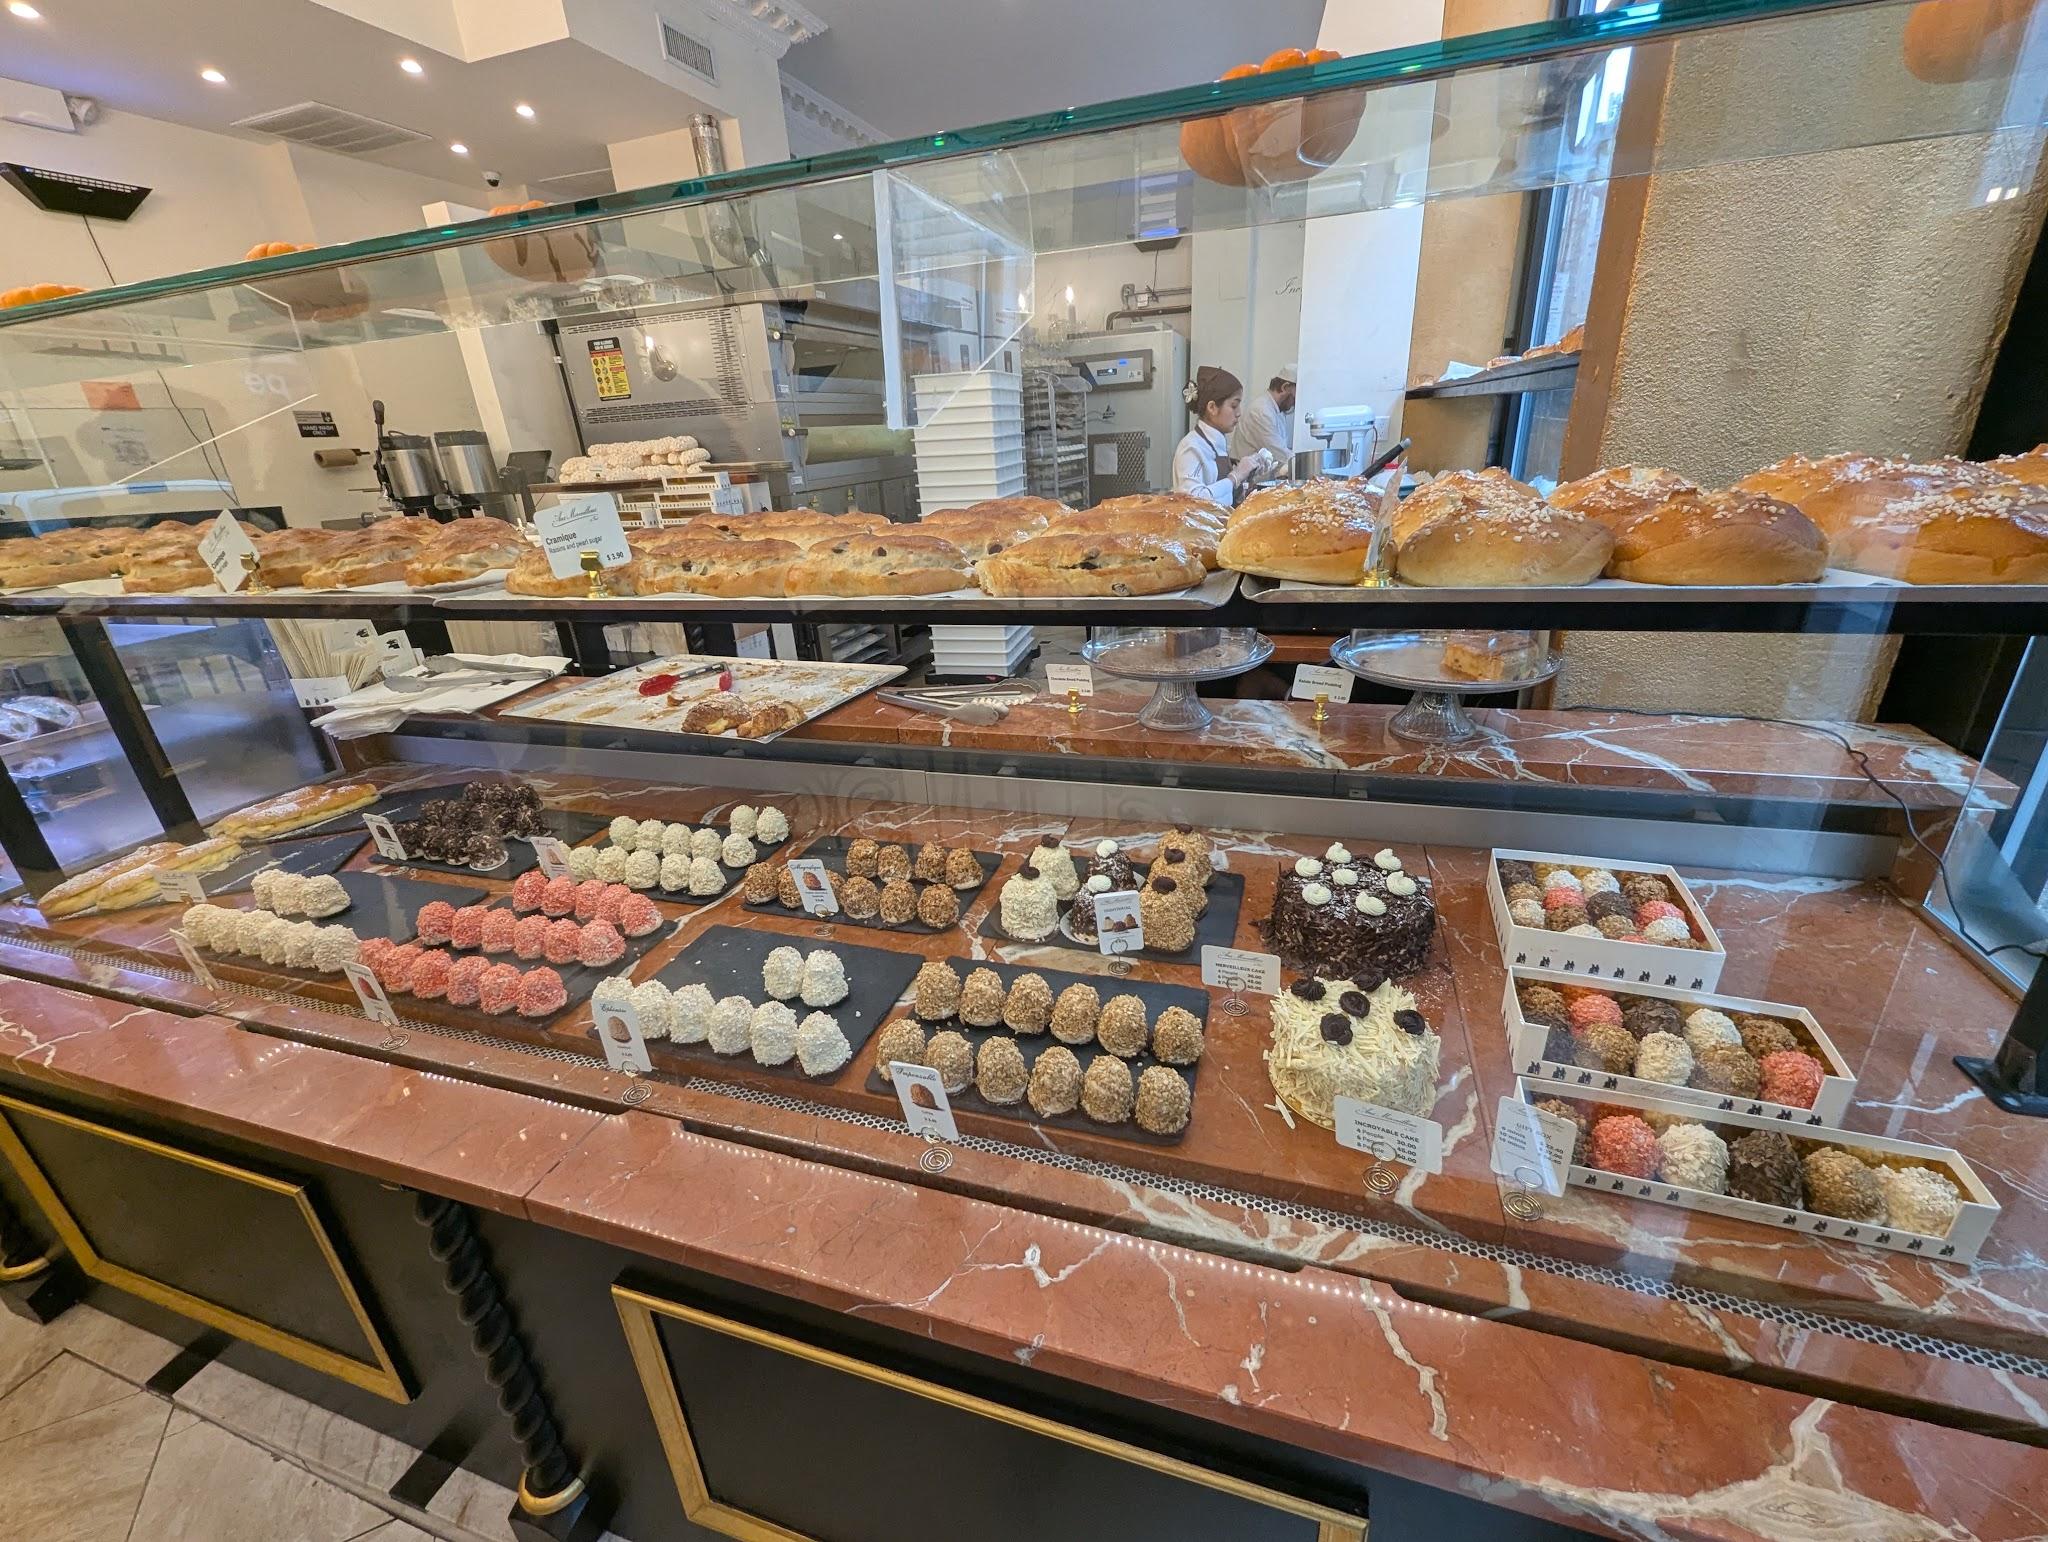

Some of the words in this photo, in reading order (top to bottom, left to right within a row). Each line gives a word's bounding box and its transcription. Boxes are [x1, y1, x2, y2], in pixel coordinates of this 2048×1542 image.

[545, 532, 577, 546] Cramique
[566, 542, 576, 550] and
[589, 535, 603, 545] sugar
[611, 551, 624, 561] 3.90
[1215, 962, 1251, 972] MERVEILLEUX
[1354, 1120, 1399, 1137] INCROYABLE
[1399, 1133, 1420, 1143] CAKE
[1362, 1129, 1384, 1140] People
[1397, 1139, 1417, 1150] 30.00
[1397, 1146, 1417, 1157] 45.00
